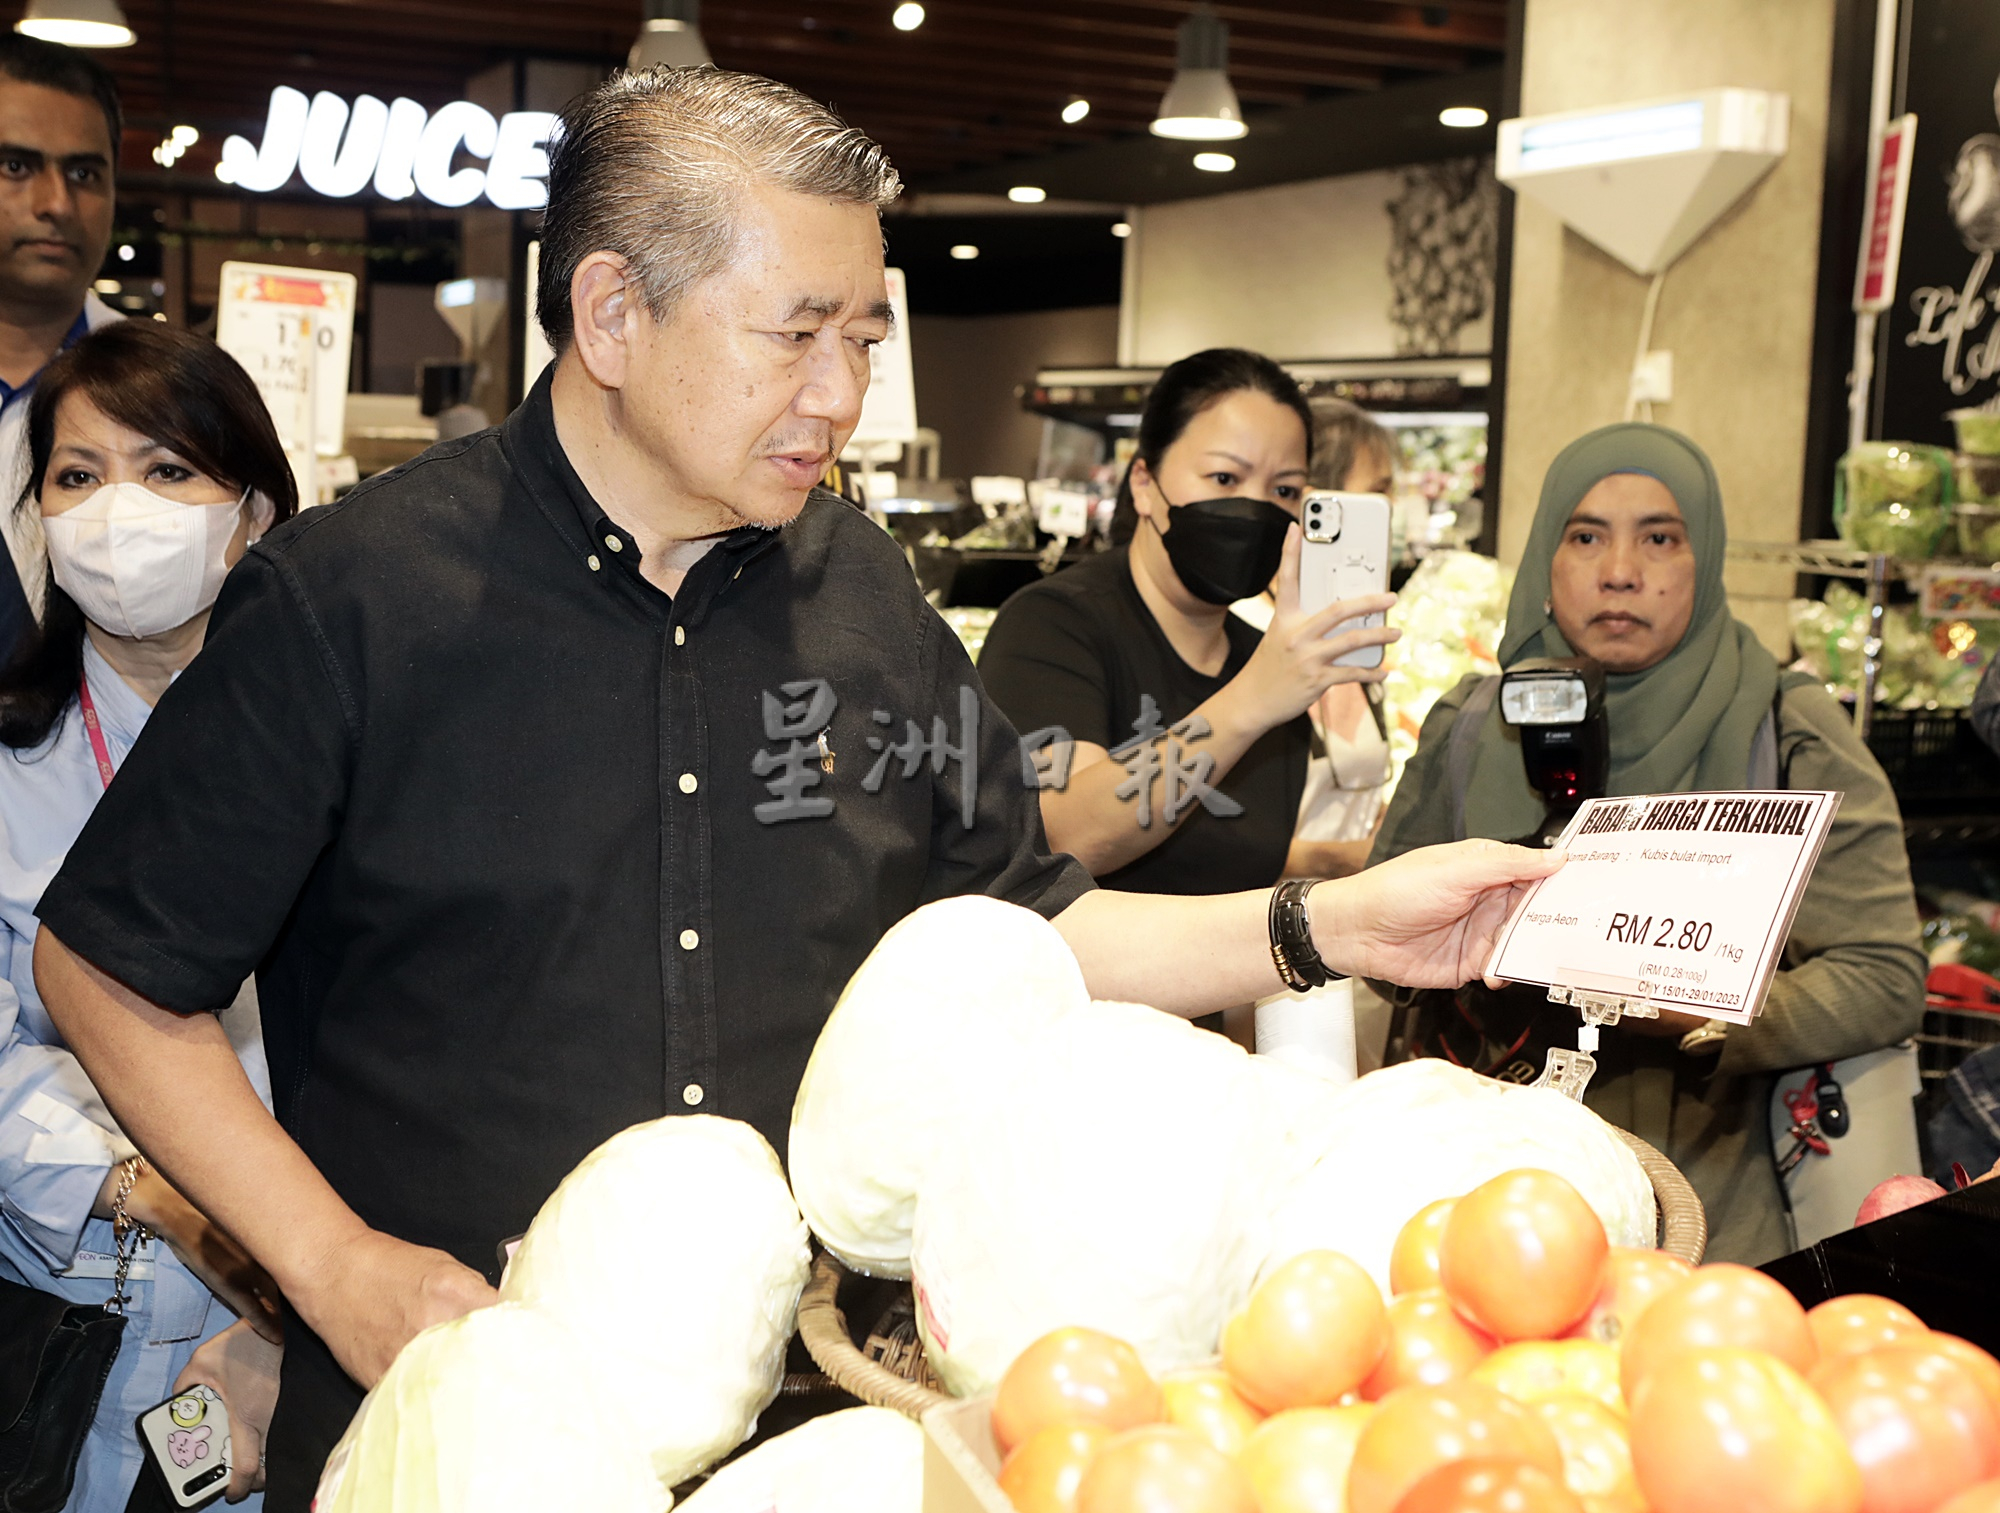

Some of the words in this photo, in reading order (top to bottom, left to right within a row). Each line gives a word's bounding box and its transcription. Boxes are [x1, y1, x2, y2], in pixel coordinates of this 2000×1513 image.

[221, 84, 566, 210] JUICE
[1545, 731, 1572, 739] Canon
[1641, 798, 1708, 831] HARGA
[1703, 799, 1813, 836] TERKAWAL
[1587, 850, 1620, 863] Barang
[1640, 848, 1669, 861] Kubis
[1670, 850, 1697, 862] bulat
[1697, 851, 1731, 865] import
[1524, 911, 1552, 925] Harga
[1552, 913, 1578, 926] Aeon
[1606, 912, 1653, 945] RM
[1653, 918, 1713, 952] 2.80
[1714, 942, 1744, 964] /1kg
[1661, 984, 1740, 1006] 15/01-29/01/2023
[78, 1252, 97, 1261] EON
